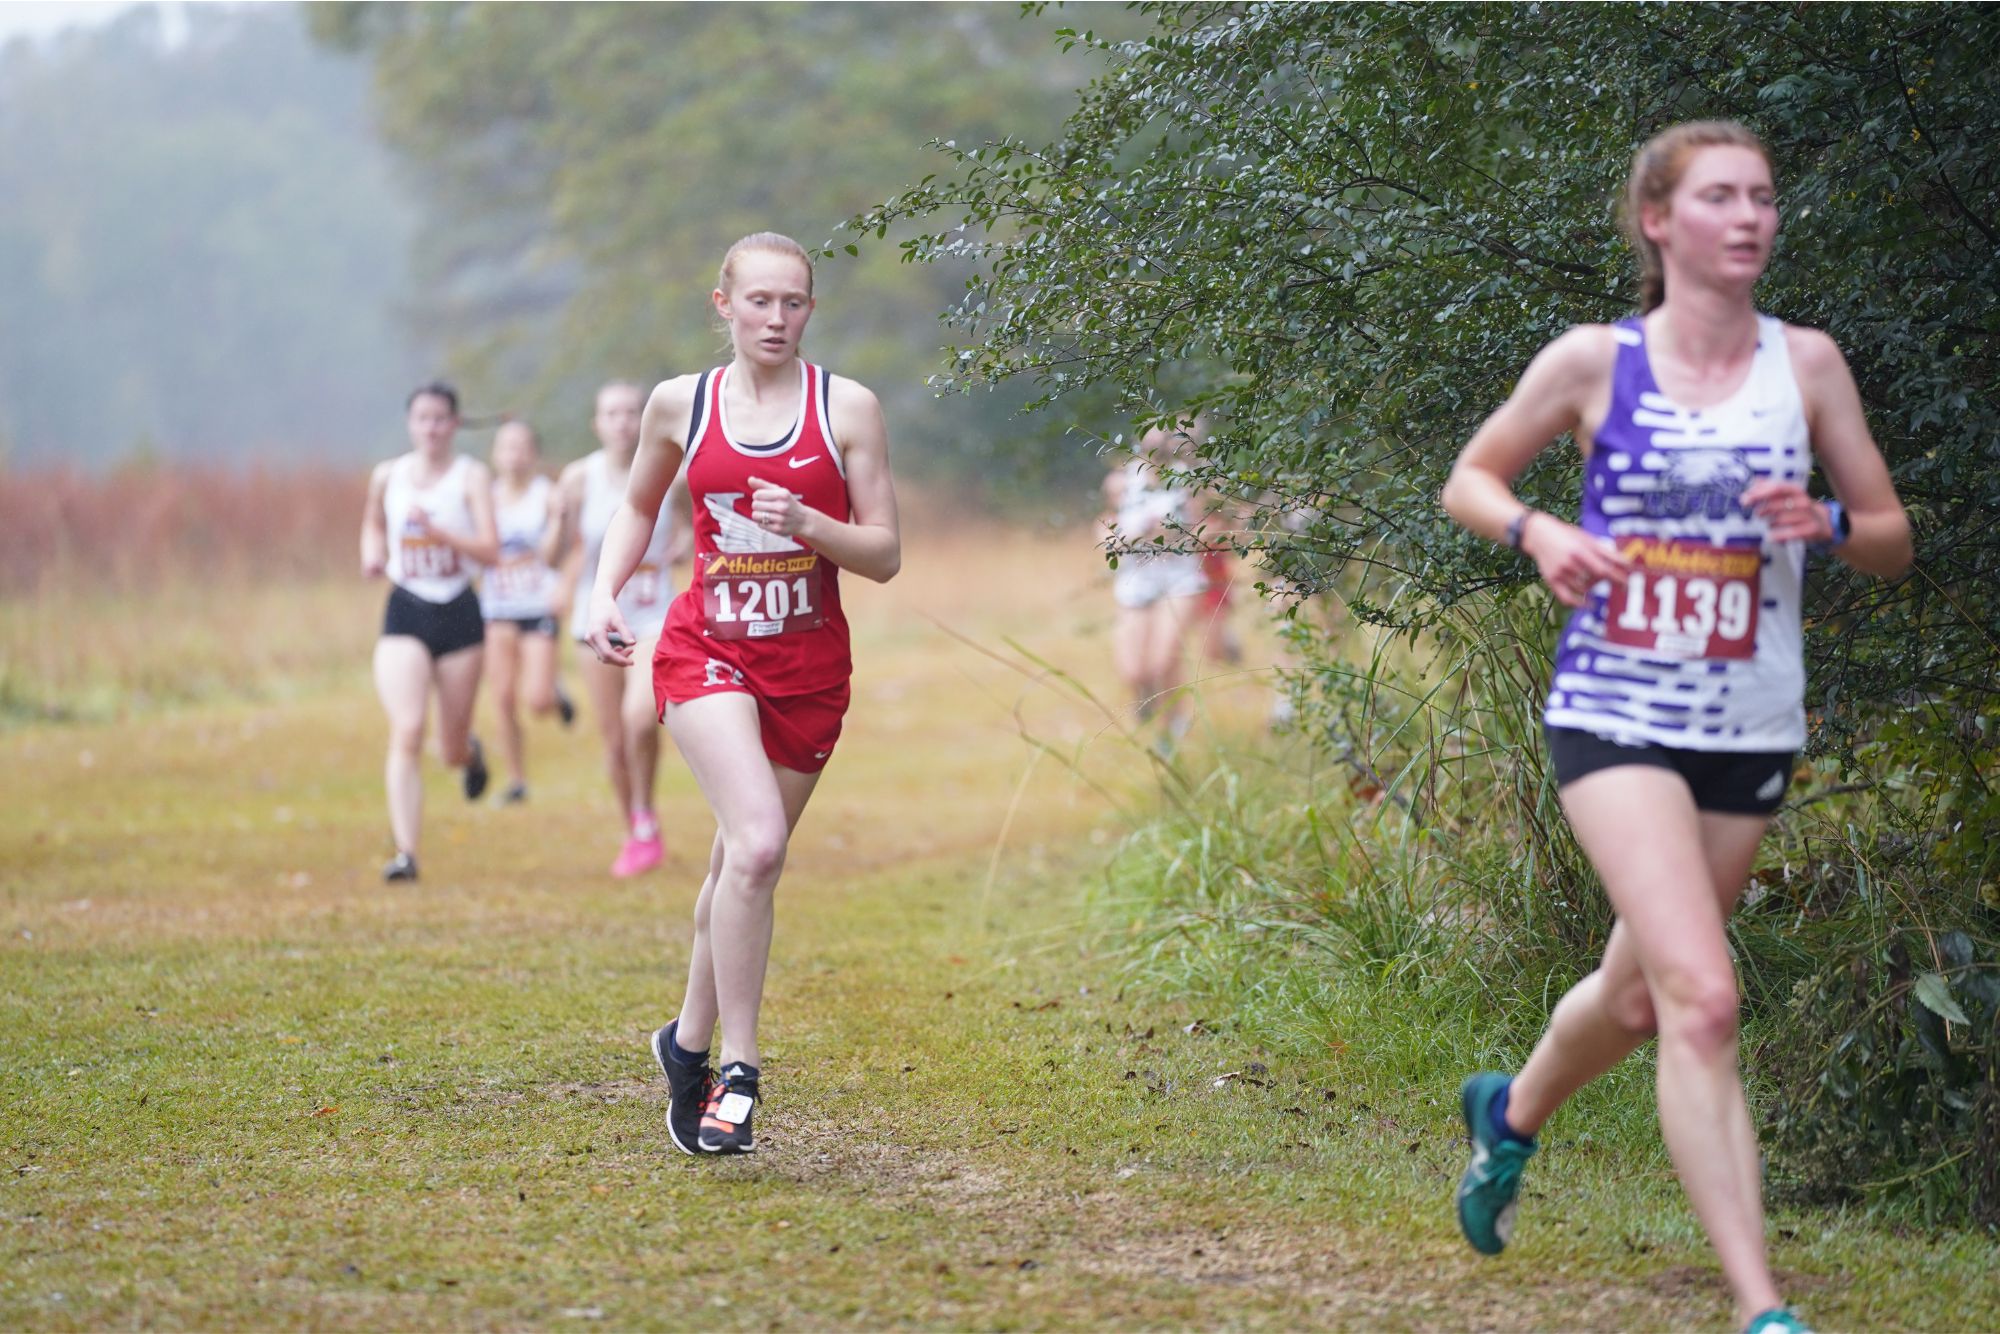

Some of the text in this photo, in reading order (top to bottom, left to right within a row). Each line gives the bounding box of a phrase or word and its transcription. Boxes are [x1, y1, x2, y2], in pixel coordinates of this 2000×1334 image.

[706, 555, 786, 574] Athletic
[713, 577, 813, 623] 1201
[1617, 571, 1752, 641] 1139
